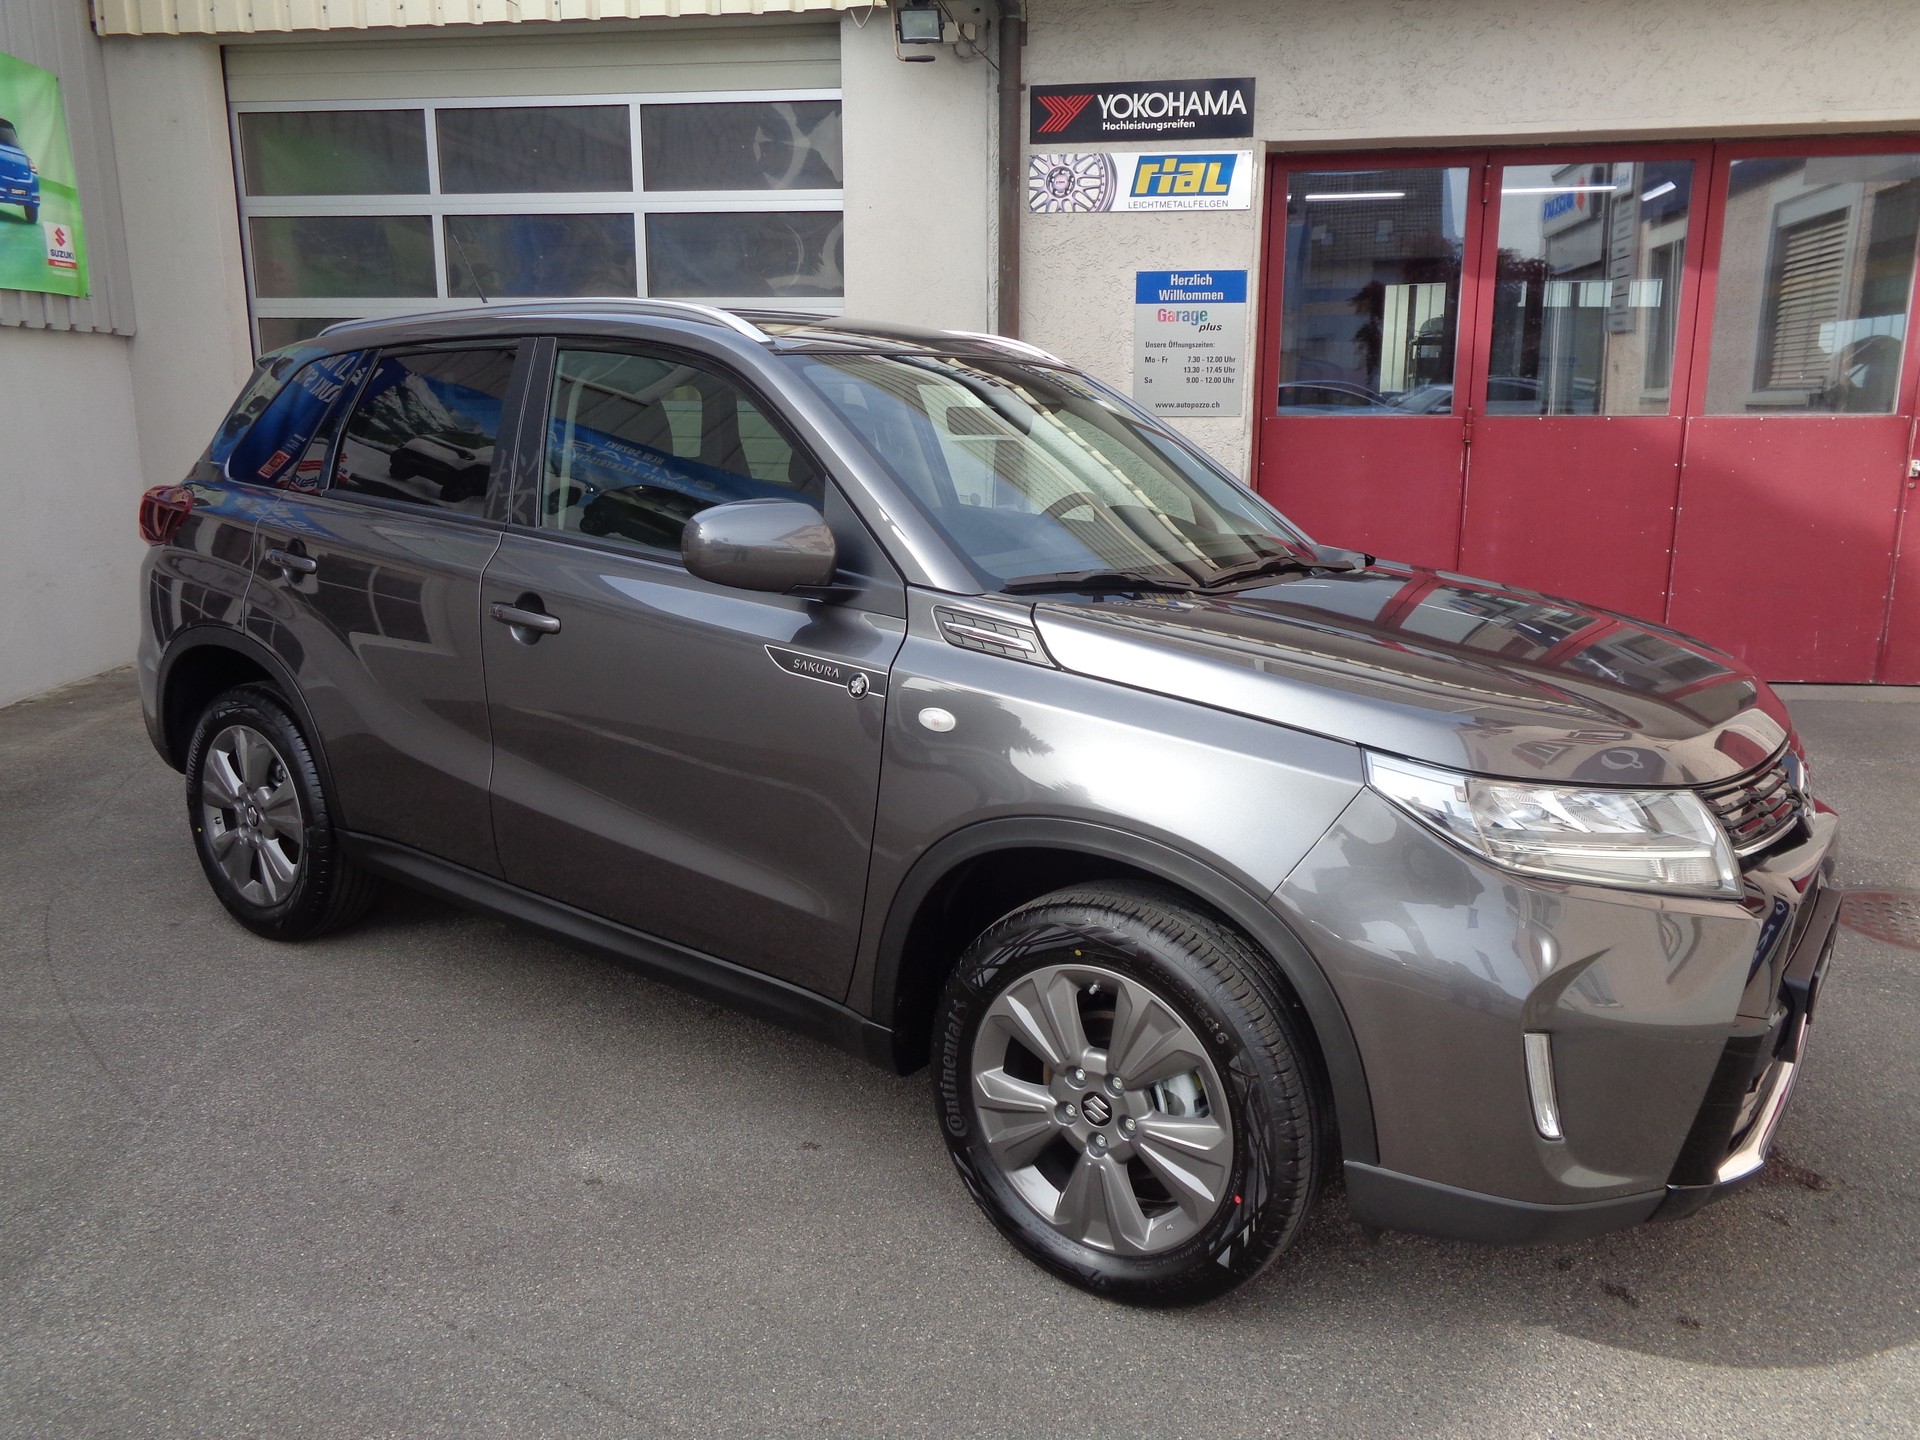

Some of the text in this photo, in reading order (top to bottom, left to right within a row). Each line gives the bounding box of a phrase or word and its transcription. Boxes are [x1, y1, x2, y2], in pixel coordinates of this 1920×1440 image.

[1097, 89, 1247, 119] YOKOHAMA
[1102, 119, 1196, 131] Hochleistungsreifen
[1128, 199, 1229, 209] LEICHTMETALLFELGEN
[50, 248, 75, 260] SUZUKI
[1171, 274, 1212, 286] Herzlich
[1159, 290, 1224, 300] Willkommen
[1157, 309, 1208, 326] Garage
[1199, 323, 1222, 333] plus
[1169, 341, 1215, 349] Öffnungszeiten:
[1155, 402, 1220, 410] www.autopozzo.ch
[793, 658, 840, 679] SAKURA
[940, 1010, 968, 1138] Continental
